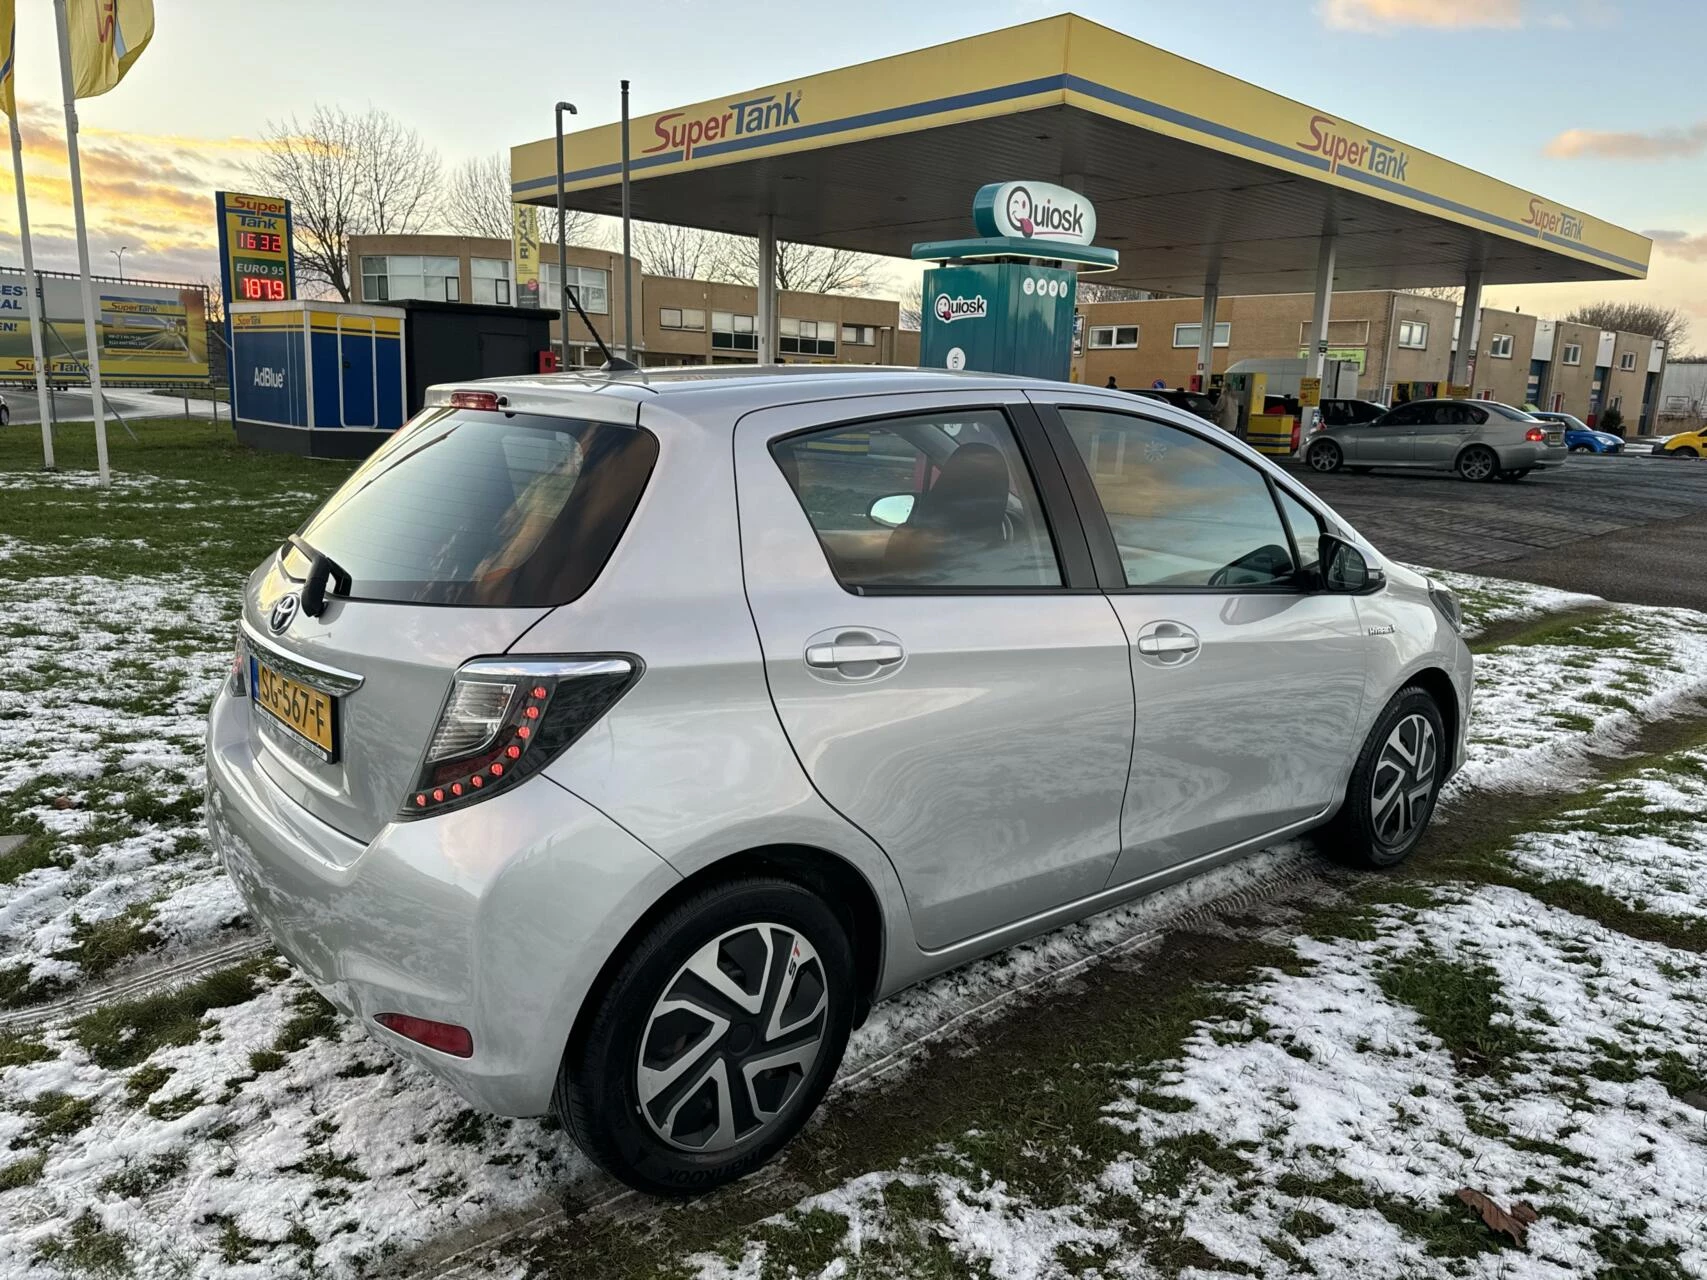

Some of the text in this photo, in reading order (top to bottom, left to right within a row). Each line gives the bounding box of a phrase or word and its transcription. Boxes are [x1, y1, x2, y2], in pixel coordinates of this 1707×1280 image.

[642, 92, 801, 160] SuperTank
[1296, 115, 1408, 181] SuperTank
[226, 196, 285, 216] Super
[236, 215, 277, 229] Tank
[1007, 186, 1083, 238] Quiosk
[1520, 197, 1584, 240] SuperTank
[236, 263, 285, 275] EURO 95
[936, 296, 985, 320] Quiosk
[8, 359, 91, 376] SuerTank
[261, 664, 325, 737] SG-567-F
